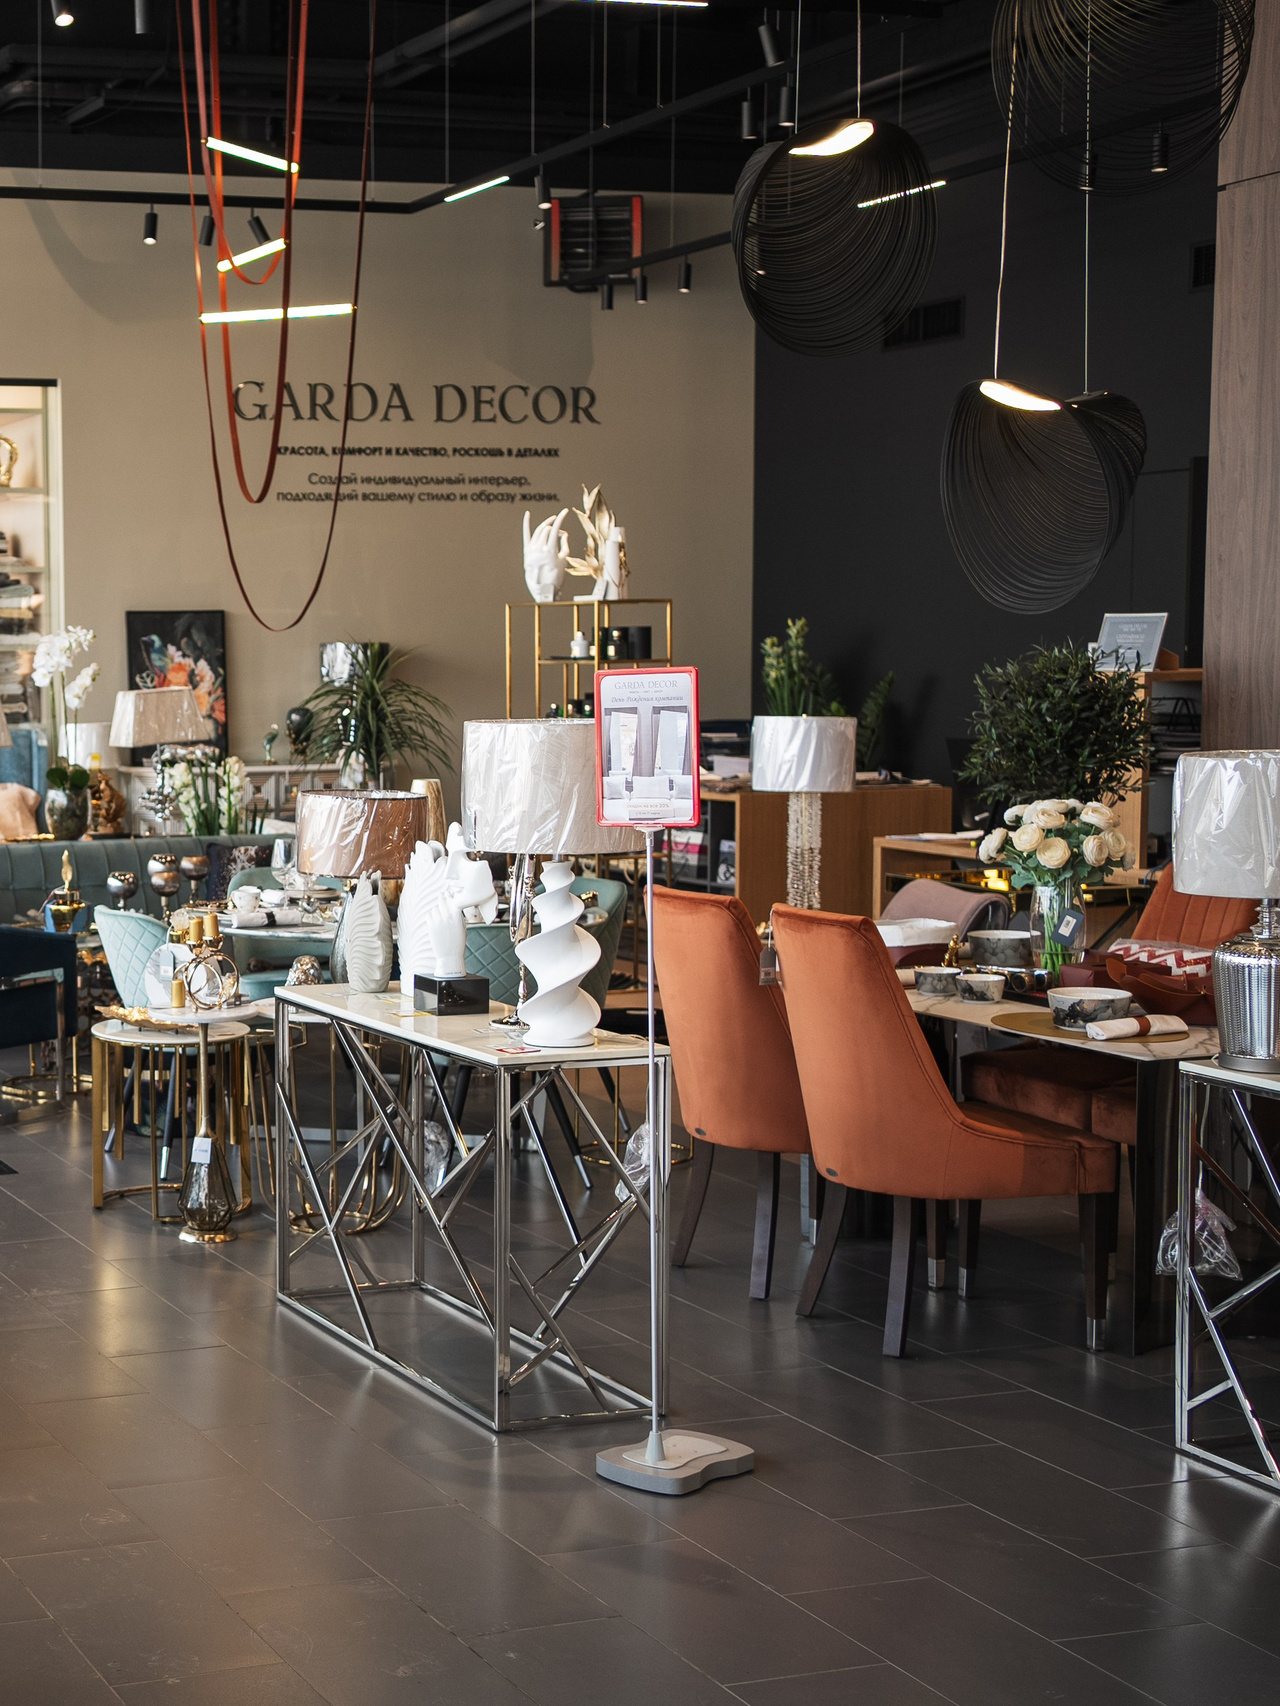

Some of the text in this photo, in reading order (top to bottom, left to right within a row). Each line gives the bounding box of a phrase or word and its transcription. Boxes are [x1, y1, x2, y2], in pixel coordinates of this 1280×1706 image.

[234, 381, 602, 425] GARDA DECOR
[276, 446, 329, 456] КРАСОТА,
[385, 446, 393, 456] И
[395, 447, 450, 458] КАЧЕСТВО,
[452, 447, 505, 457] РОСКОШЬ
[506, 448, 514, 457] В
[515, 448, 560, 458] ДЕТАЛЯХ
[360, 473, 465, 487] индивидуальный
[468, 476, 531, 487] интерьер,
[361, 491, 415, 503] вашему
[417, 492, 457, 501] стилю
[459, 493, 468, 501] и
[470, 490, 516, 503] образу
[519, 493, 560, 502] жизни.
[614, 680, 678, 689] GARDA DECOR
